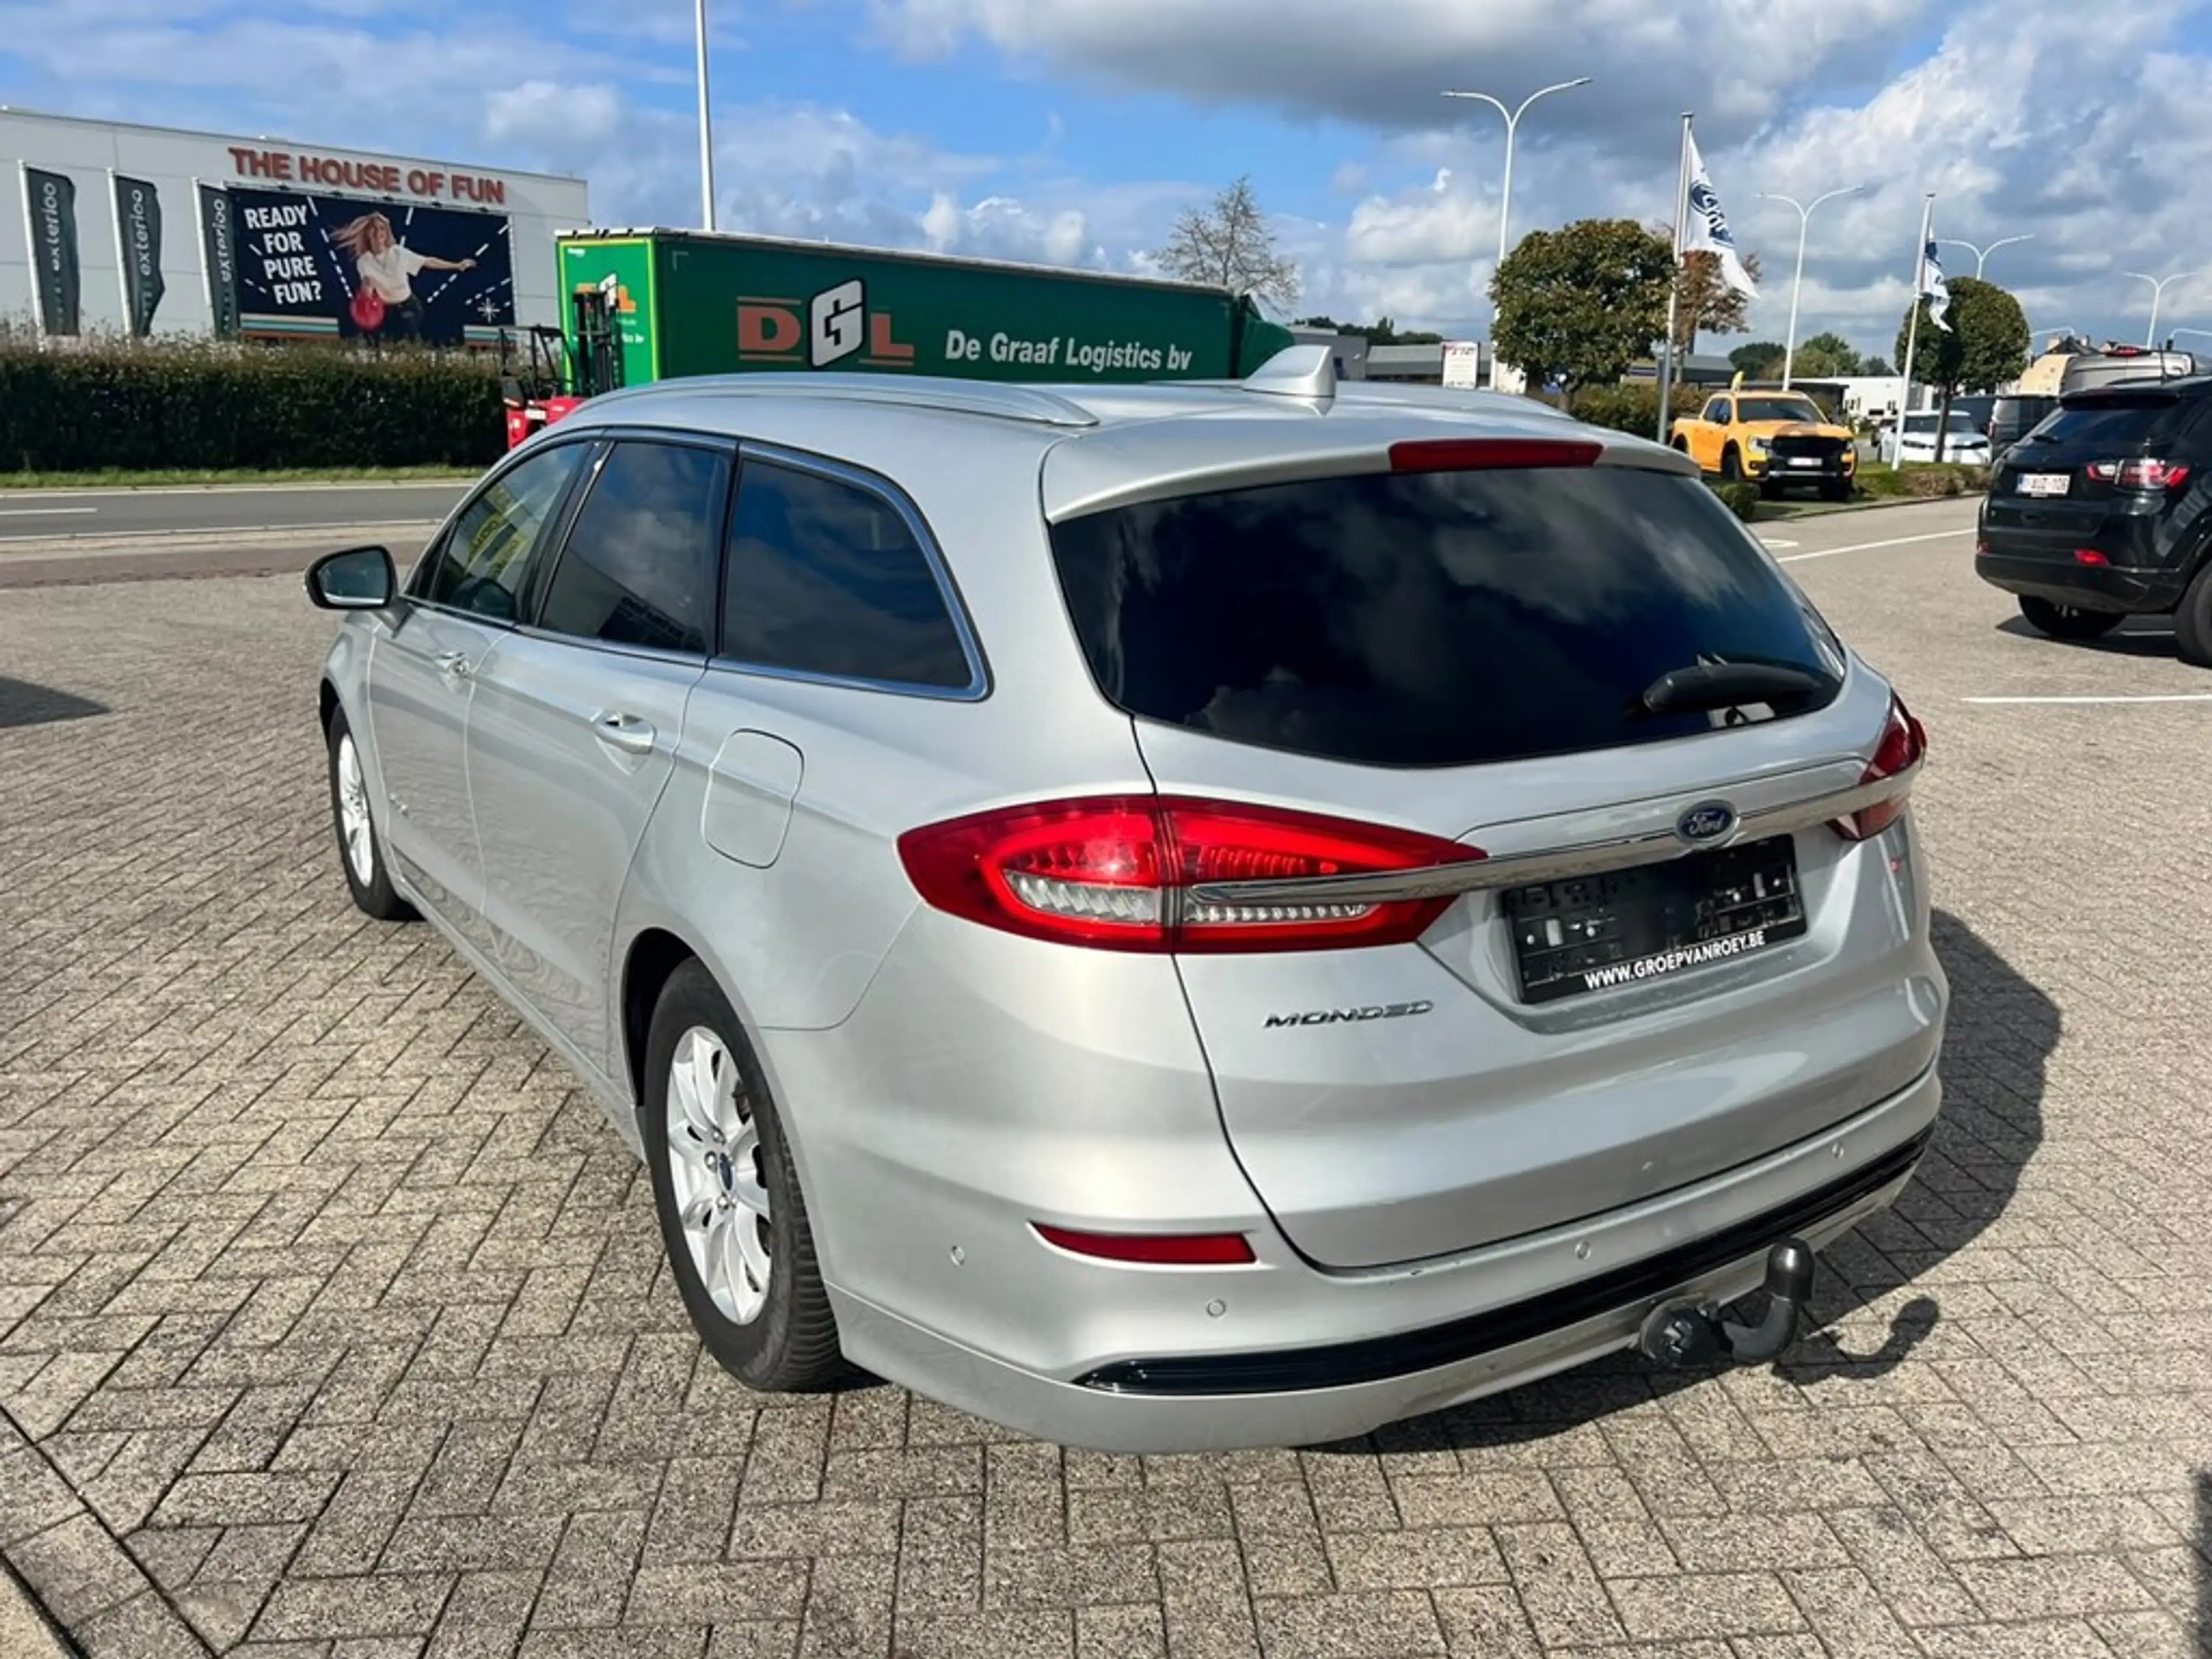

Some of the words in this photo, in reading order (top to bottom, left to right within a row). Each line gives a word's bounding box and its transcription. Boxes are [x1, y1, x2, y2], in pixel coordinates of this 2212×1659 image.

[229, 146, 291, 180] THE
[299, 156, 402, 192] HOUSE
[407, 169, 444, 197] OF
[450, 175, 505, 204] FUN
[130, 189, 152, 276] exterioo
[244, 204, 308, 229] READY
[263, 231, 305, 253] FOR
[263, 255, 317, 281] PURE
[272, 280, 322, 305] FUN?
[945, 329, 981, 361] De
[989, 332, 1060, 365] Graaf
[1065, 338, 1162, 373] Logistics
[1167, 344, 1192, 370] bv
[1584, 930, 1766, 990] WWW.GROEPVANROEY.BE
